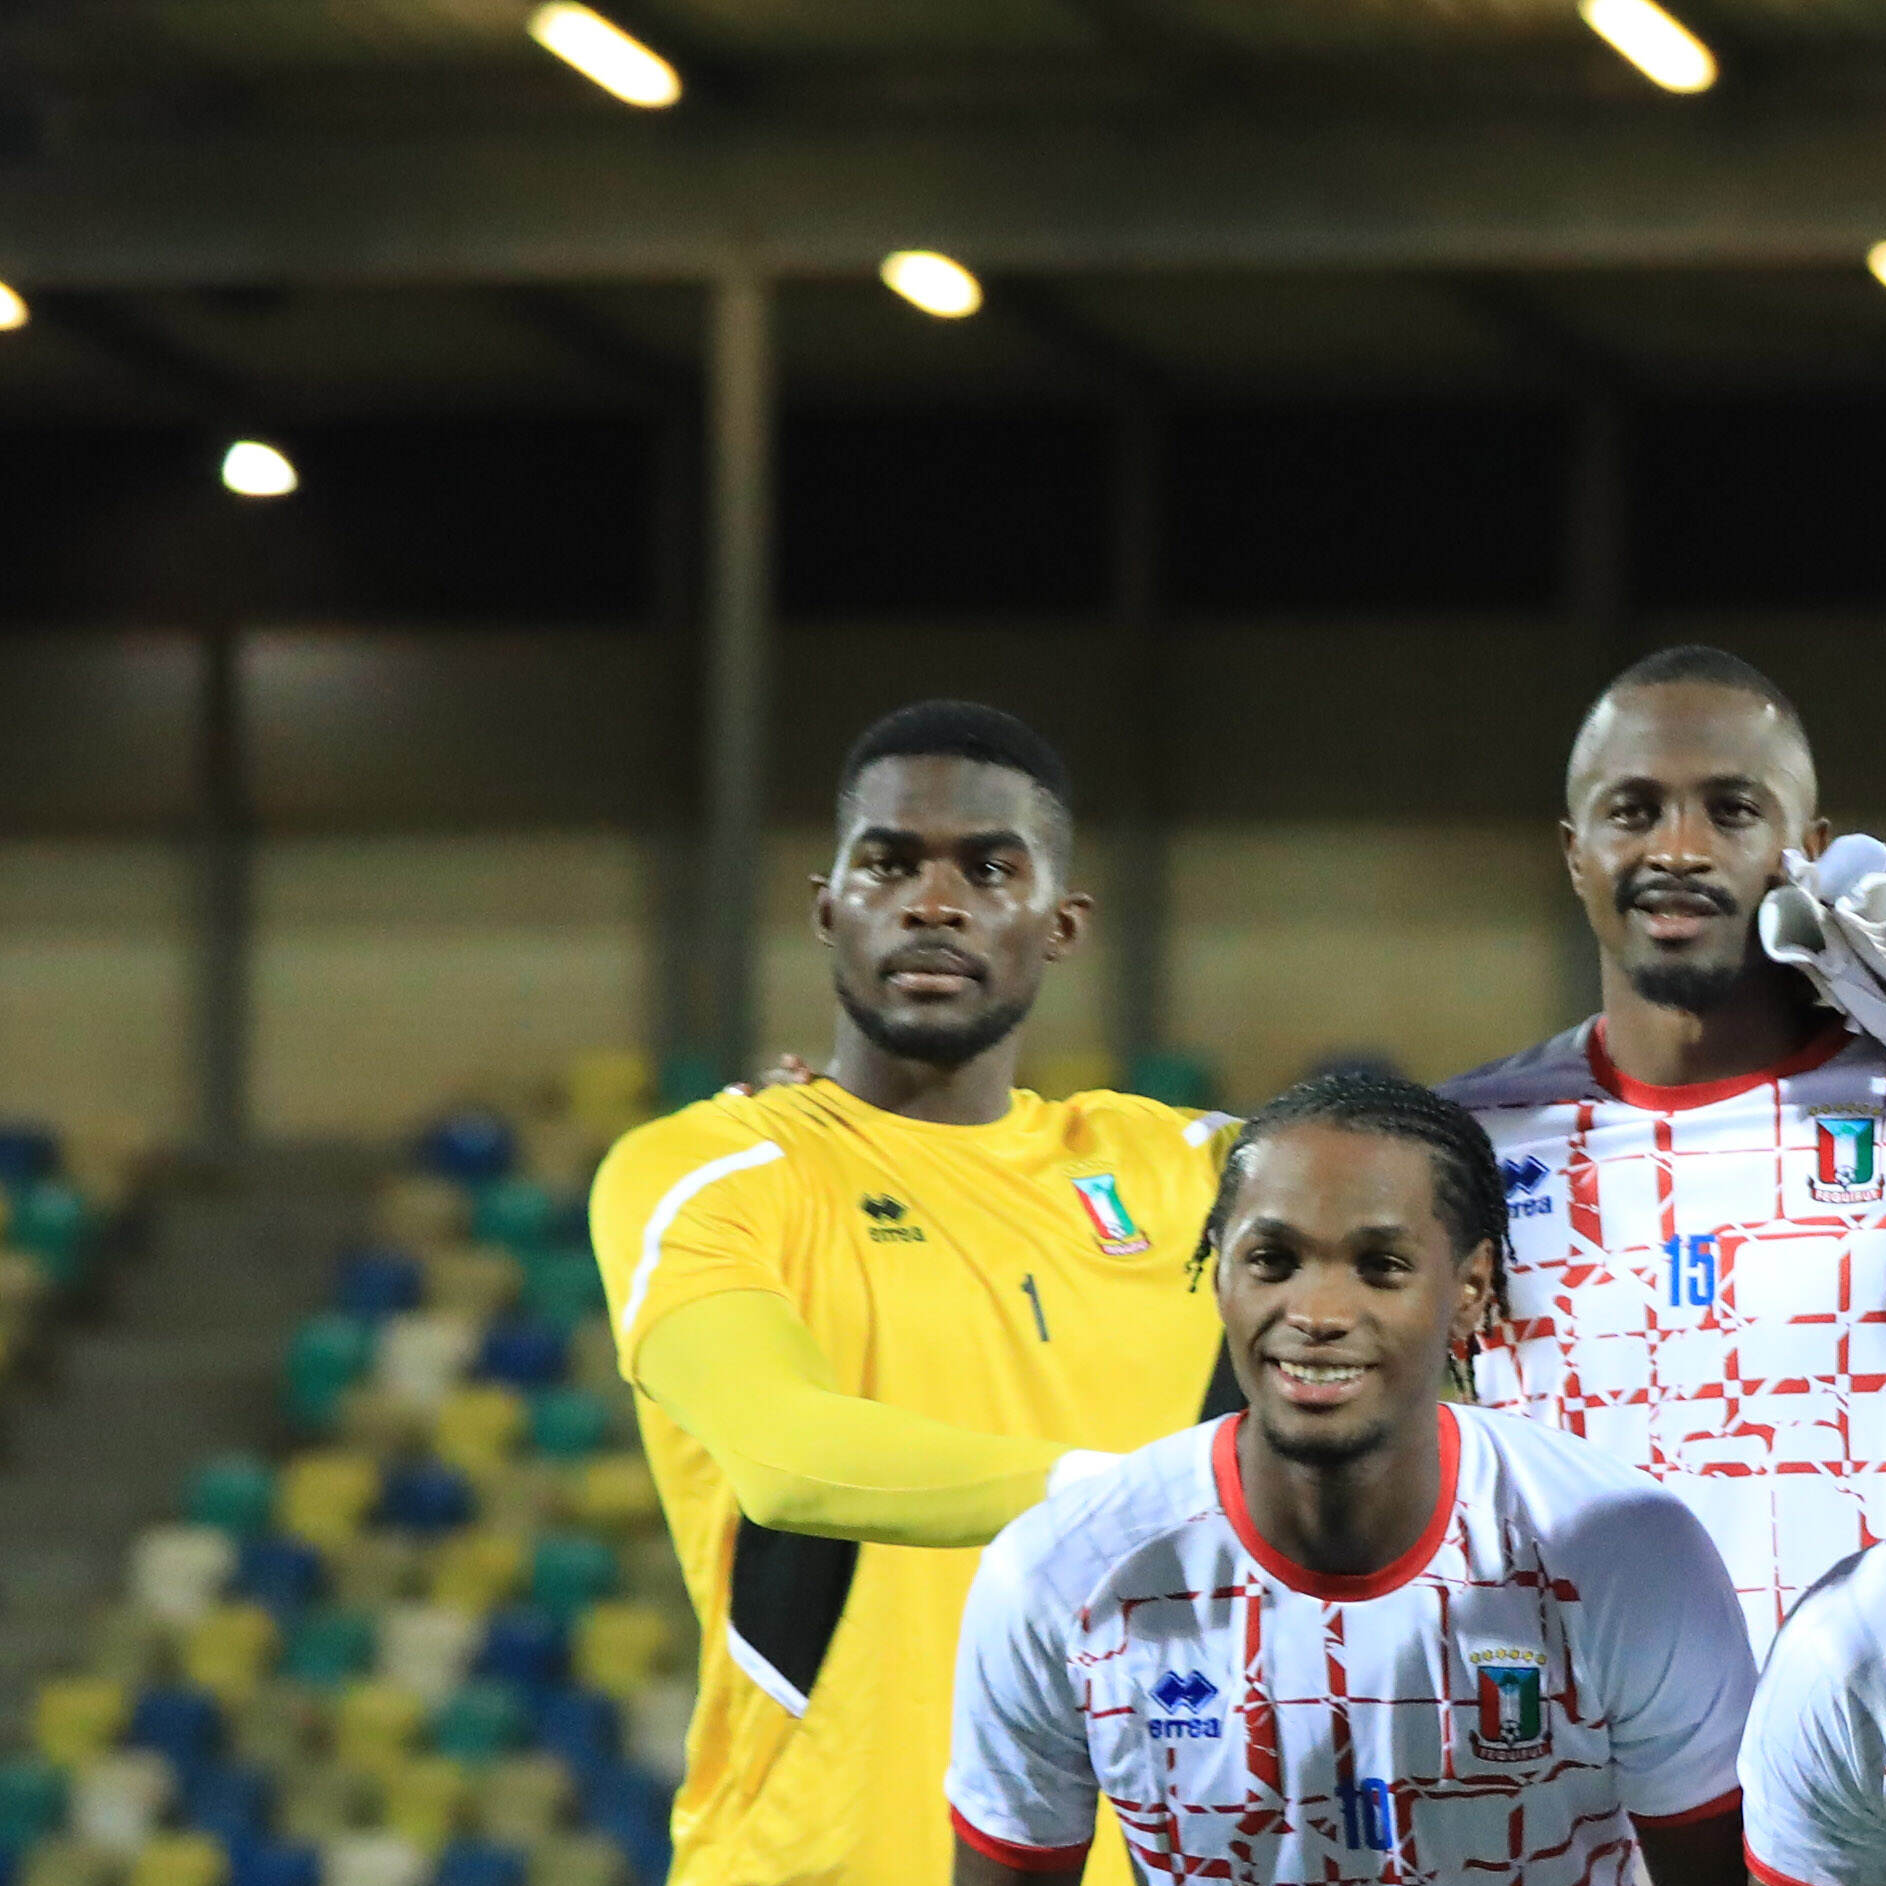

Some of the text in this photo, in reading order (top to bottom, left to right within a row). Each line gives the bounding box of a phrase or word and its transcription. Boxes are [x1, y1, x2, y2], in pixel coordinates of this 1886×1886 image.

[1663, 1234, 1718, 1306] 15
[1019, 1273, 1050, 1343] 1
[1147, 1717, 1222, 1740] errea
[1336, 1777, 1392, 1850] 10
